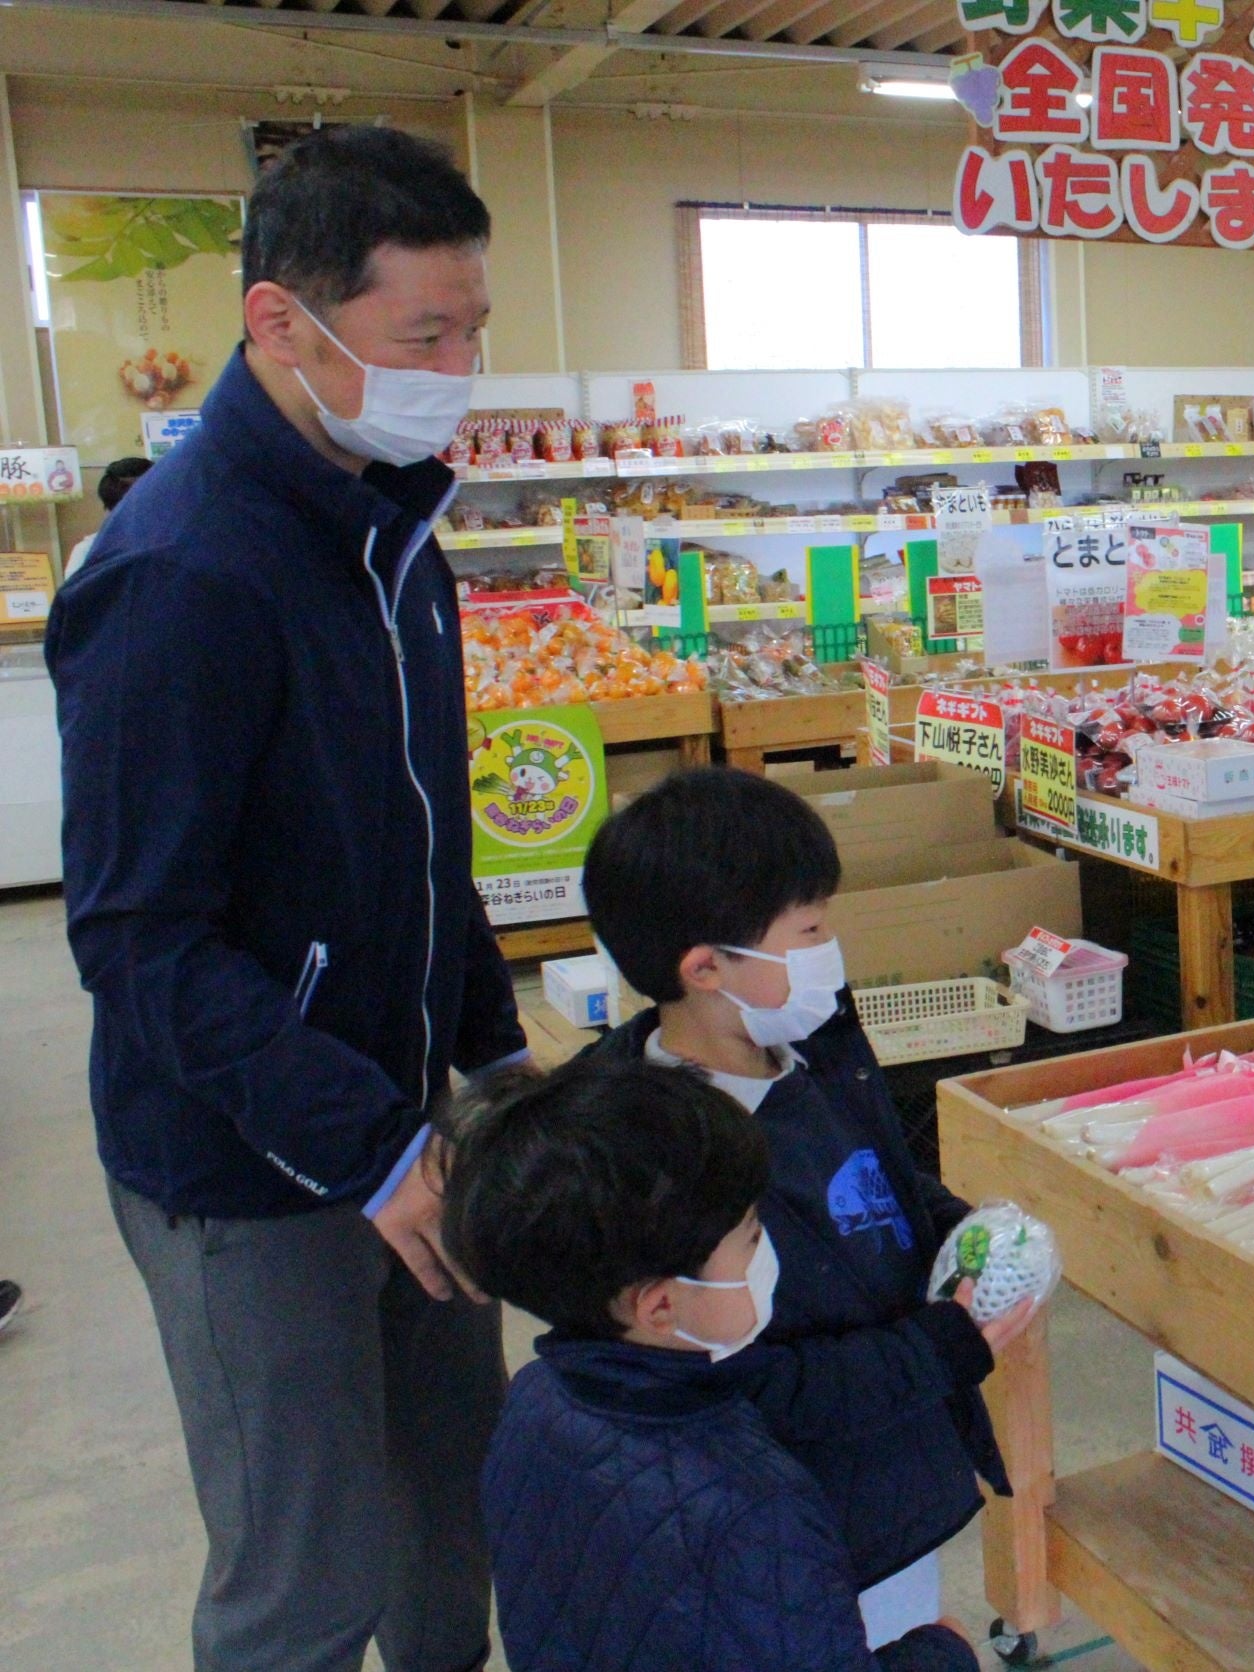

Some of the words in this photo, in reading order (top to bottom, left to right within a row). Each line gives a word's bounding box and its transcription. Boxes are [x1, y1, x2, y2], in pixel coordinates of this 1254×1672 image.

[1053, 533, 1126, 568] とまと
[918, 720, 1002, 761] 下山悦子さん
[266, 1151, 295, 1178] POLO
[295, 1173, 329, 1196] GOLF
